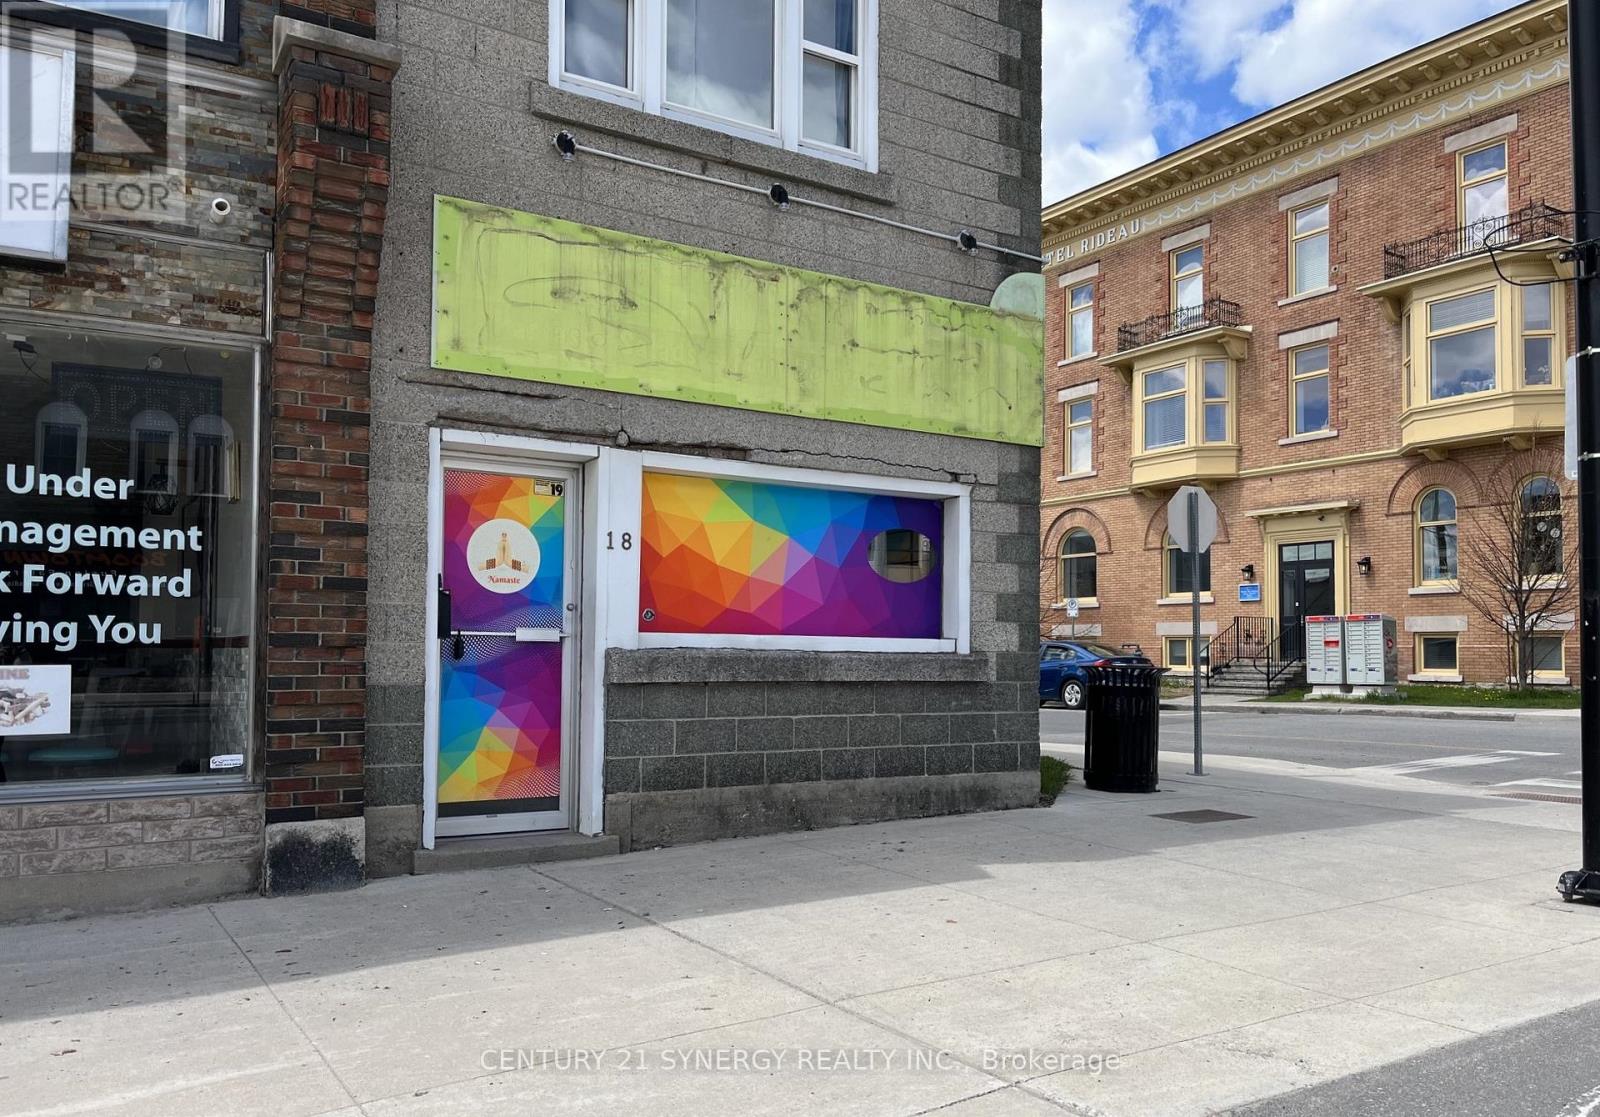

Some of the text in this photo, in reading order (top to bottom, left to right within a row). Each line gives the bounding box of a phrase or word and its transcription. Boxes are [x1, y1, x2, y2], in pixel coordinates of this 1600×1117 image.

[1080, 218, 1141, 254] RIDEAU
[7, 464, 134, 500] Under
[551, 483, 563, 496] 19
[0, 520, 203, 553] nagement
[606, 531, 632, 551] 18
[23, 564, 191, 597] Forward
[488, 576, 521, 584] Namaste
[88, 615, 161, 644] You
